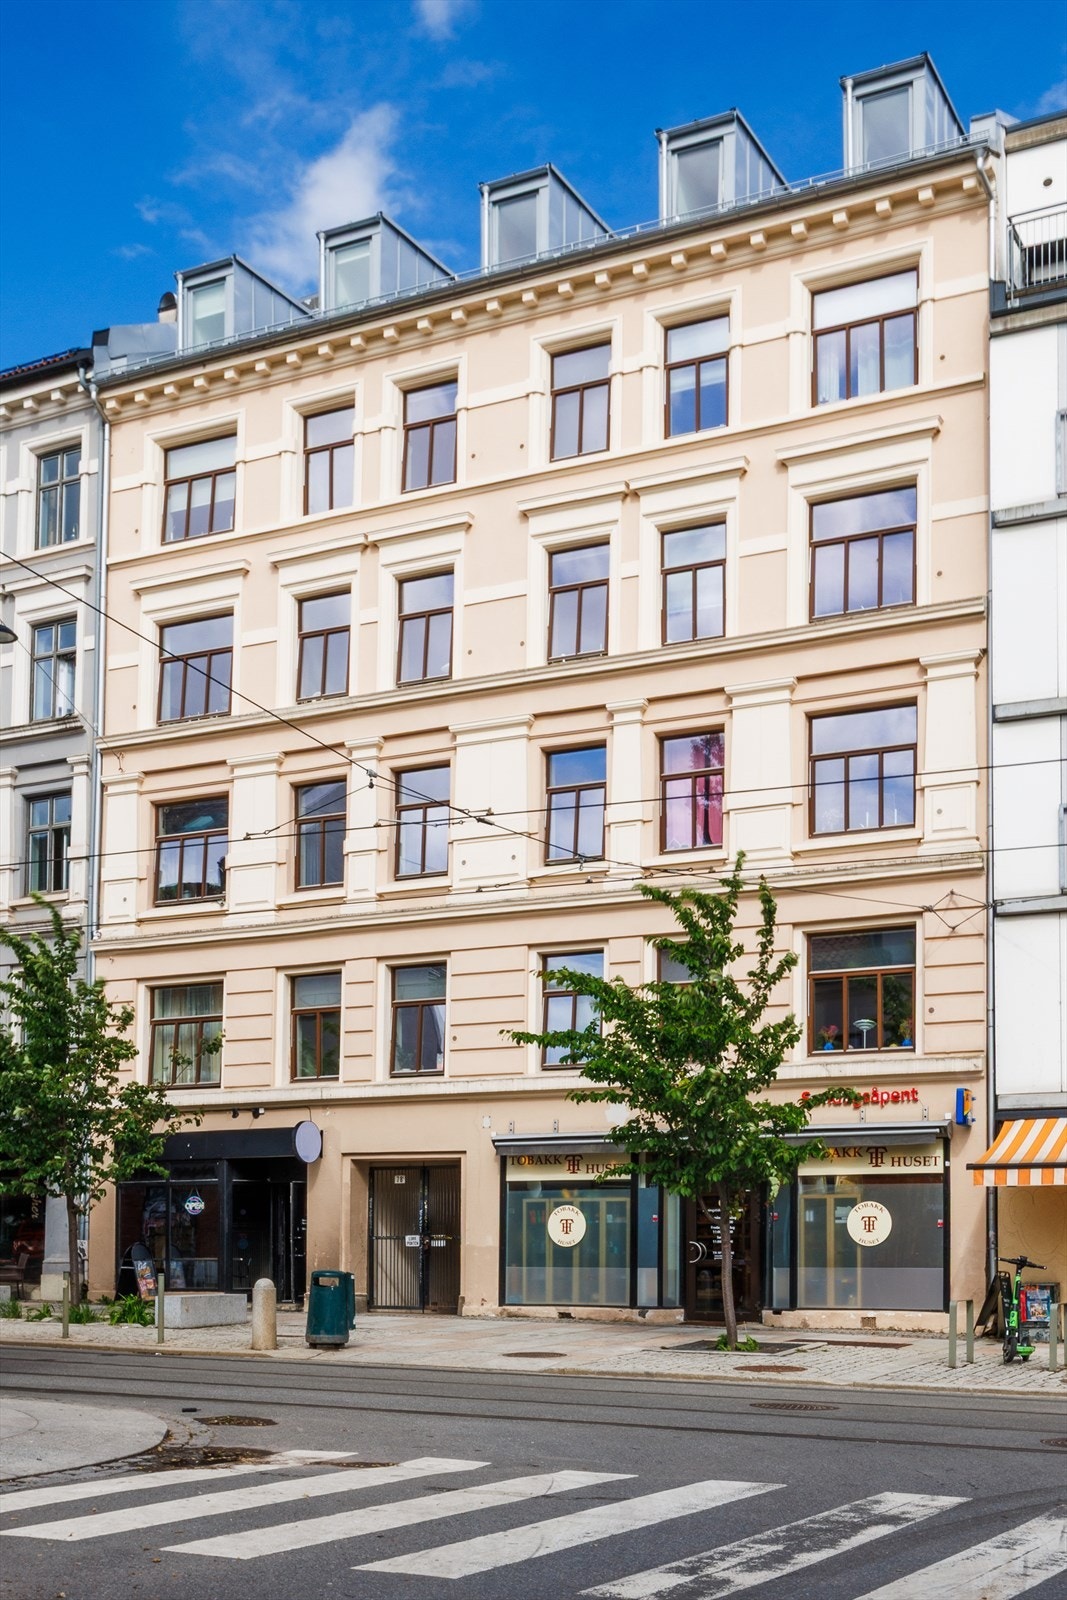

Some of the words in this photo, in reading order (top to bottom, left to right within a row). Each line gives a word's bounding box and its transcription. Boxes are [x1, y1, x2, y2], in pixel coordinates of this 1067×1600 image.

[510, 1155, 562, 1166] TOBAKK
[586, 1163, 626, 1174] HUS
[891, 1156, 940, 1167] HUSET
[854, 1202, 885, 1213] TOBAKK
